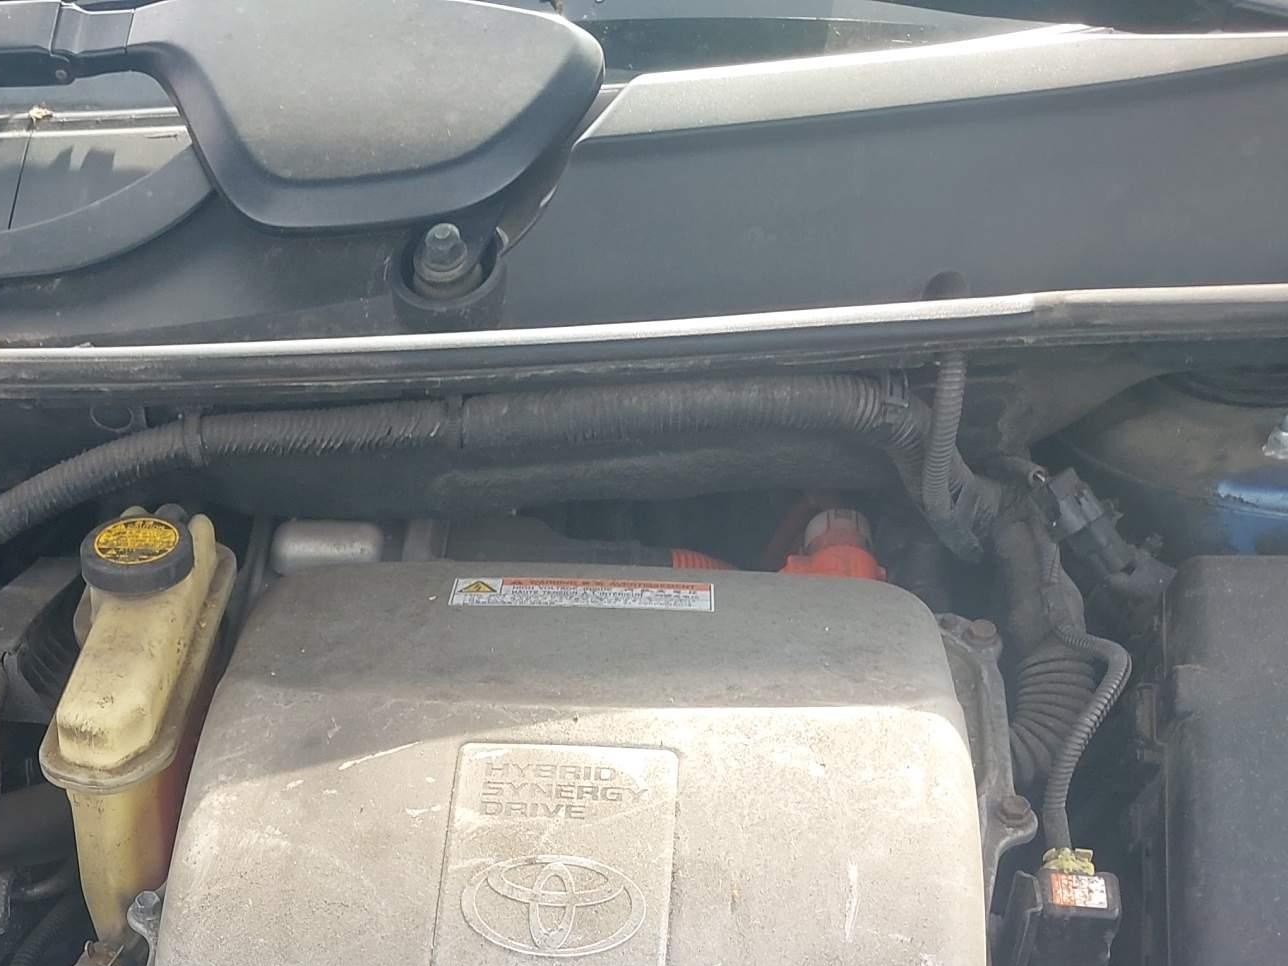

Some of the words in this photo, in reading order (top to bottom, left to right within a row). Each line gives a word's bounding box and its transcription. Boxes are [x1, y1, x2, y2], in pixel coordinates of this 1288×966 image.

[484, 762, 616, 782] HYBRID
[482, 780, 648, 802] SYNERGY
[480, 800, 586, 820] DRIVE
